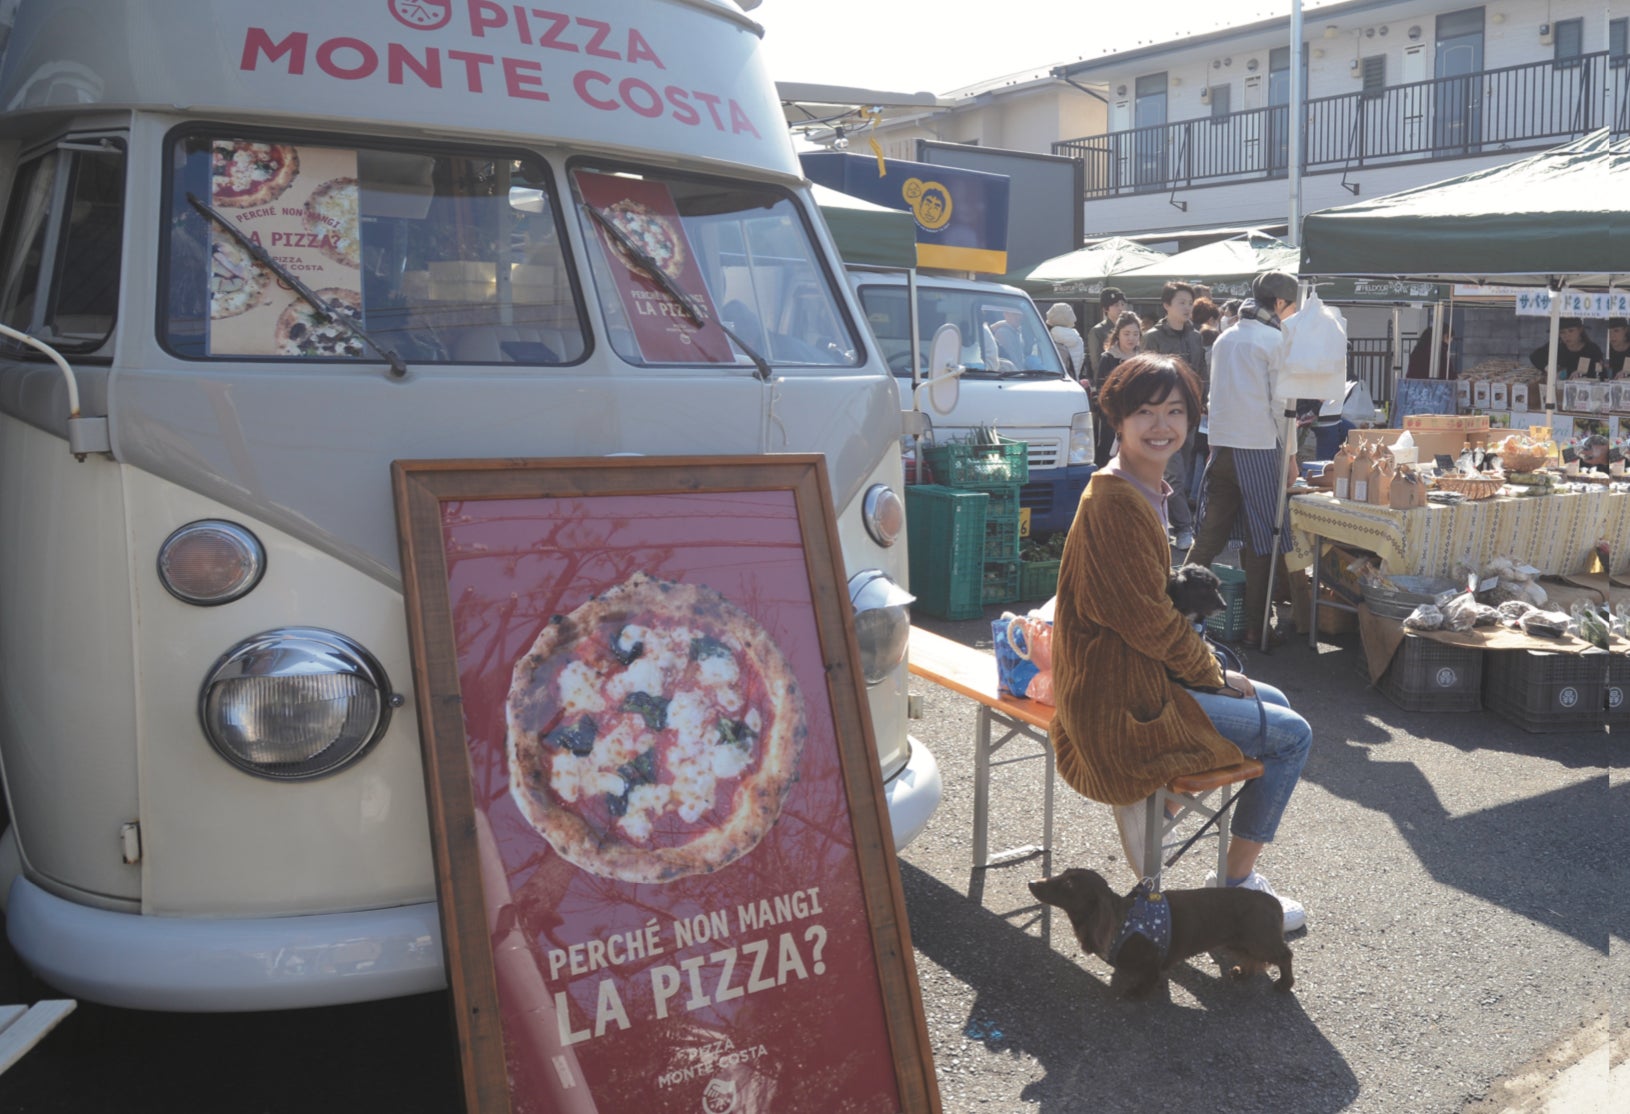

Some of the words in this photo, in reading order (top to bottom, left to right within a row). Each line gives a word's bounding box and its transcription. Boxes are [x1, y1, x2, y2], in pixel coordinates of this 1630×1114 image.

[468, 0, 667, 70] PIZZA
[239, 27, 550, 101] MONTE
[573, 70, 762, 140] COSTA
[235, 206, 276, 222] PERCHÉ
[282, 207, 303, 216] NON
[271, 232, 341, 249] PIZZA?
[272, 256, 303, 264] PIZZA
[635, 301, 657, 316] LA
[659, 302, 709, 319] PIZA?
[548, 918, 664, 981] PERCHÉ
[673, 910, 729, 949] NON
[737, 887, 823, 932] MANGI
[554, 979, 631, 1047] LA
[651, 925, 828, 1020] PIZZA?
[658, 1062, 714, 1089] MONTE
[718, 1044, 768, 1069] COSTA
[687, 1039, 735, 1061] PIZZA
